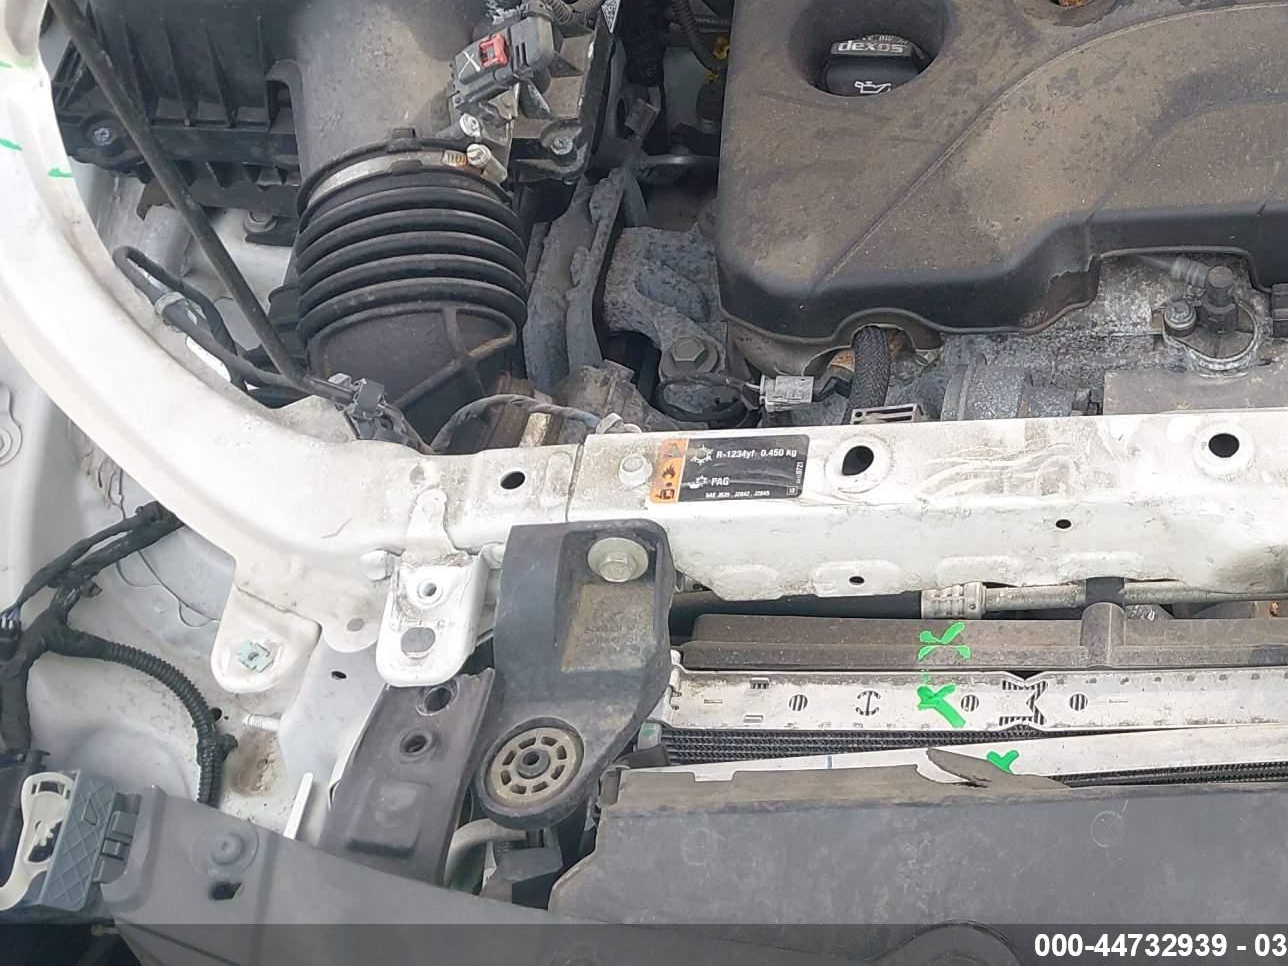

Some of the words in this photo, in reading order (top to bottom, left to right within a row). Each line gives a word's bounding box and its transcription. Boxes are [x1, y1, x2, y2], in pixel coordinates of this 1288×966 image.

[838, 40, 906, 53] dexos
[716, 449, 755, 459] R-1234yf
[760, 448, 785, 458] 0.450
[786, 448, 798, 458] kg
[711, 477, 730, 486] PAG
